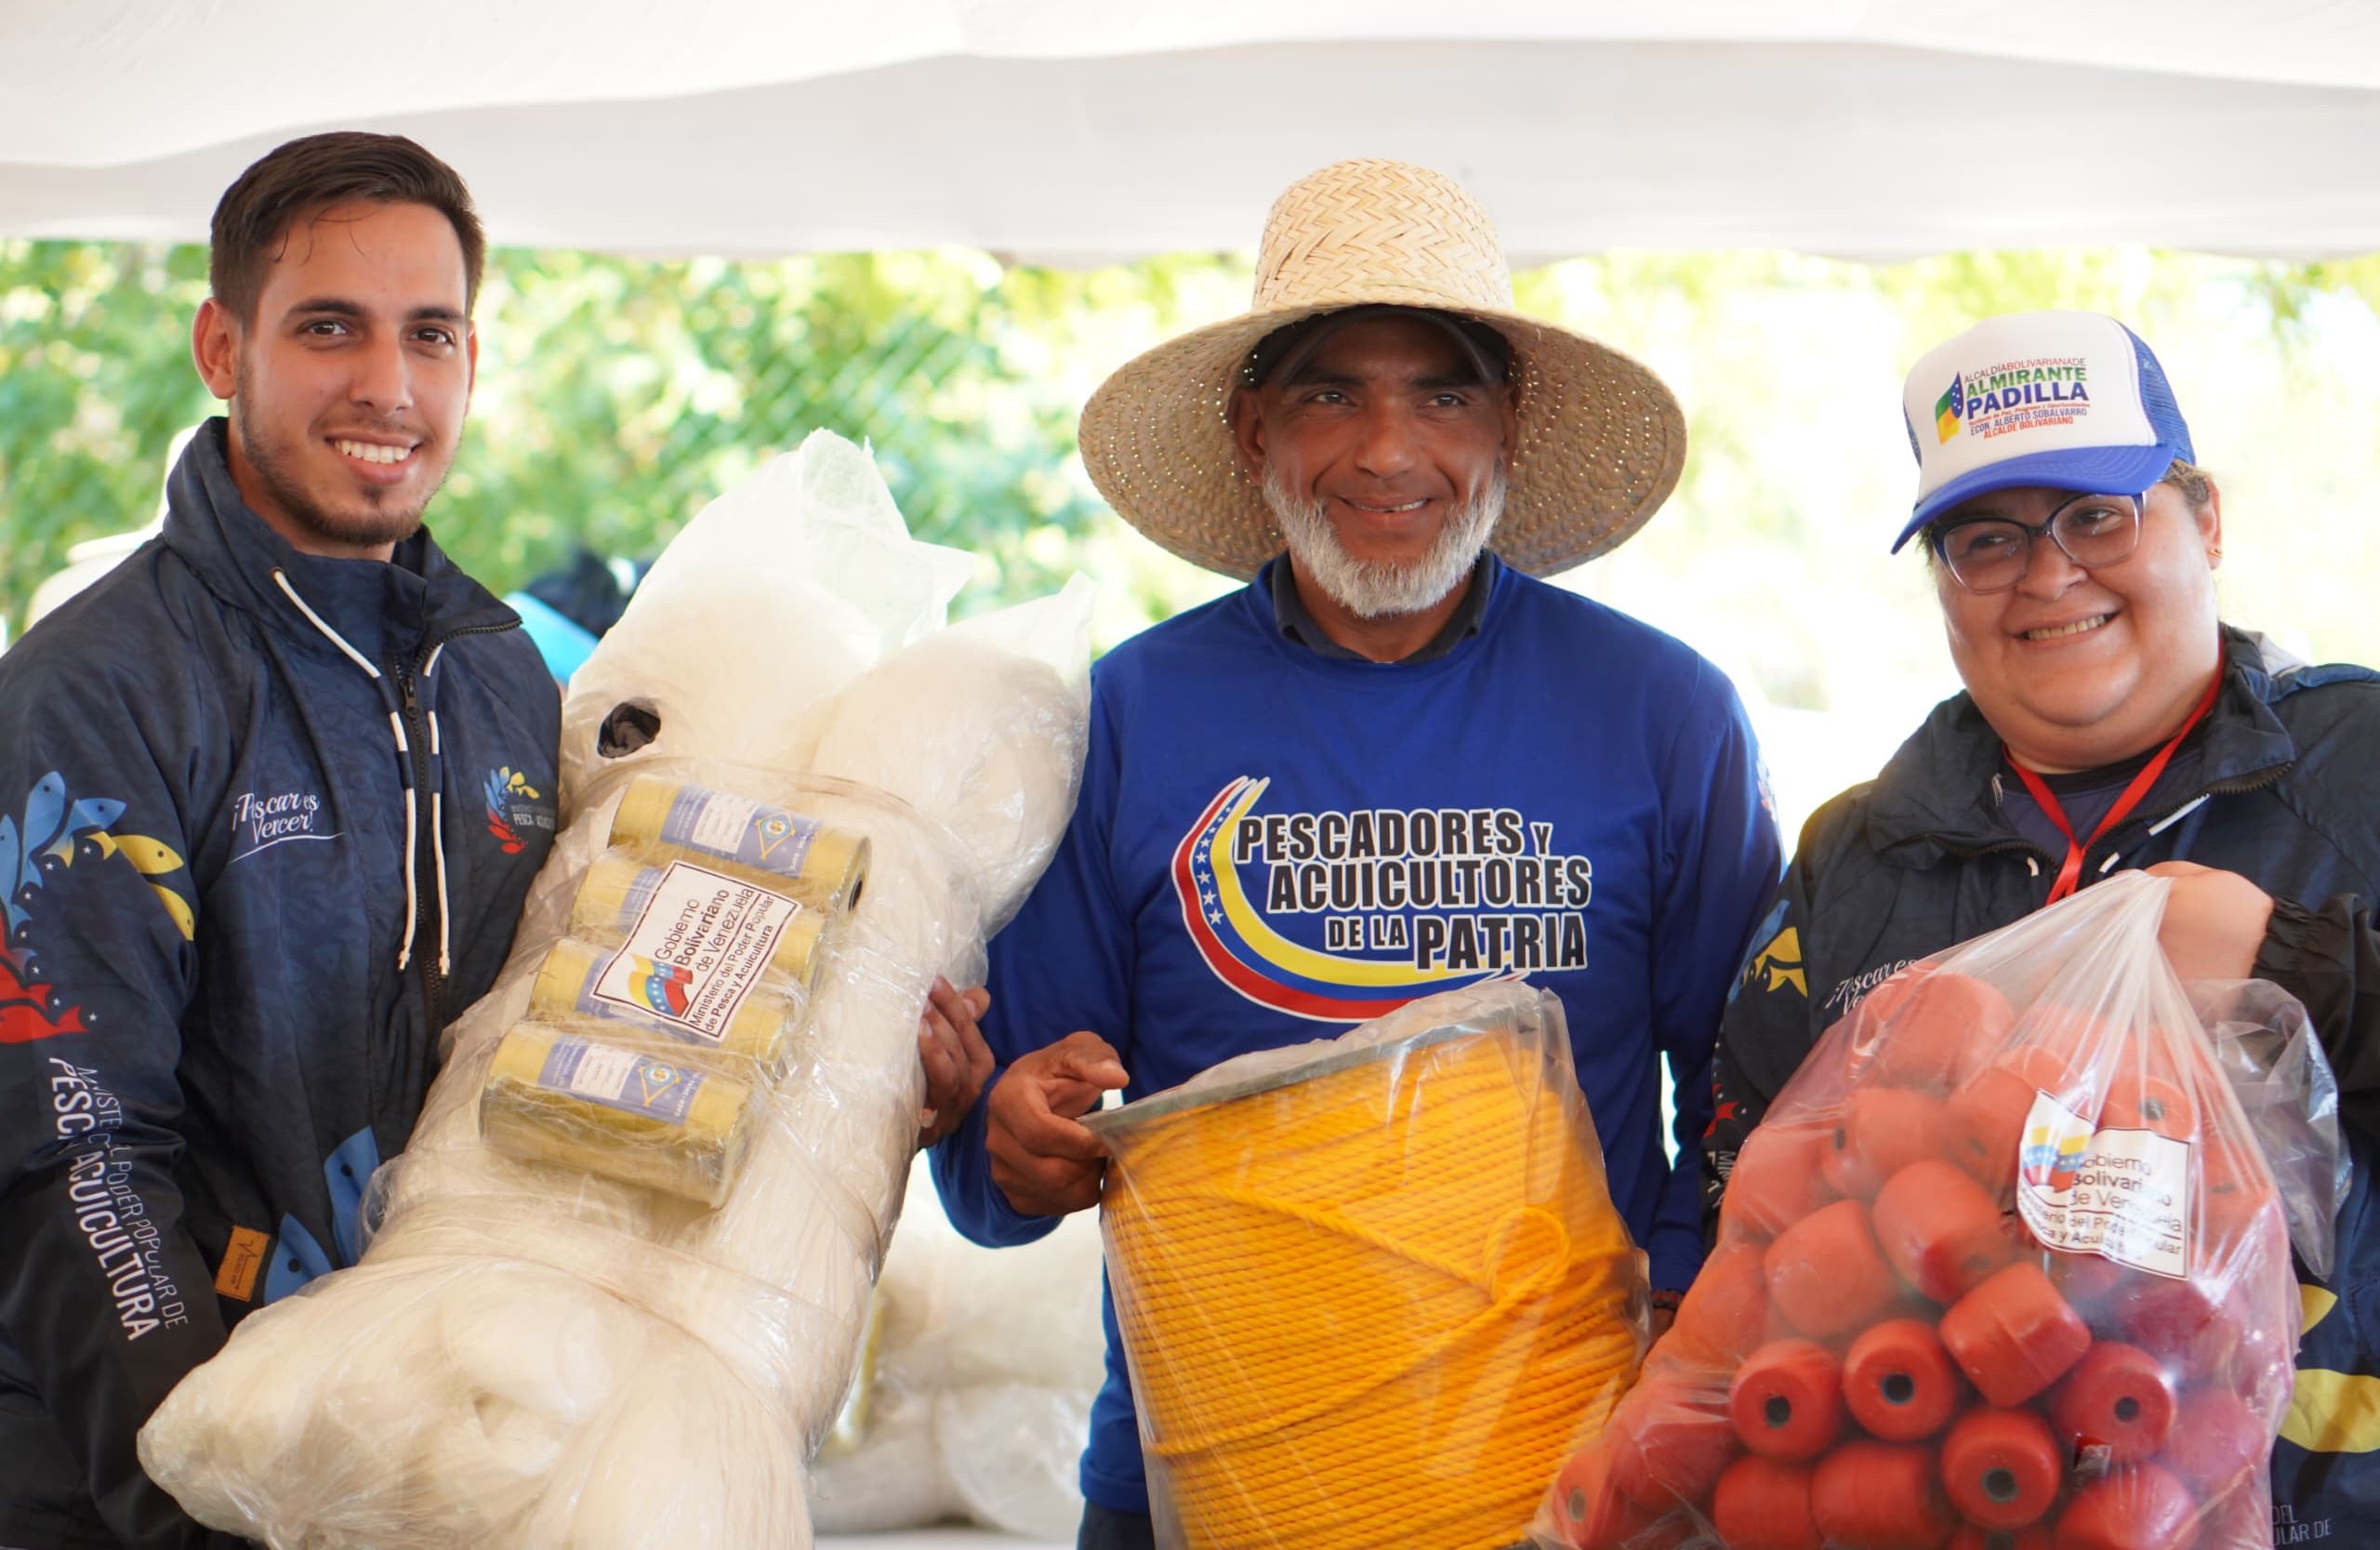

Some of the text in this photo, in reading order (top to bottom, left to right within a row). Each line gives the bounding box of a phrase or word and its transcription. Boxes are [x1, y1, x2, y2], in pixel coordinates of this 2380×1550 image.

[1966, 366, 2088, 399] ALMIRANTE
[1966, 381, 2090, 420] PADILLA
[1984, 416, 2074, 439] ALCALDE BOLIVARIANO
[1994, 413, 2030, 428] ALBERTO
[2032, 408, 2088, 420] SOBALVARRO
[1236, 809, 1553, 864] PESCADORES Y
[1266, 855, 1592, 913] ACUICULTORES
[654, 898, 699, 960] Gobierno
[674, 889, 730, 966] Bolivariano
[696, 956, 714, 972] de
[707, 888, 755, 953] Venezuela
[735, 924, 774, 979] Acuicultura
[1326, 912, 1588, 973] DE LA PATRIA
[689, 895, 775, 1027] Ministerio del Poder Popular
[705, 1016, 718, 1031] de
[711, 987, 735, 1017] Pesca
[68, 1150, 161, 1341] ACUICULTURA
[107, 1160, 143, 1220] PODER
[126, 1219, 177, 1300] POPULAR
[162, 1302, 189, 1330] DE
[2313, 1518, 2333, 1539] DE
